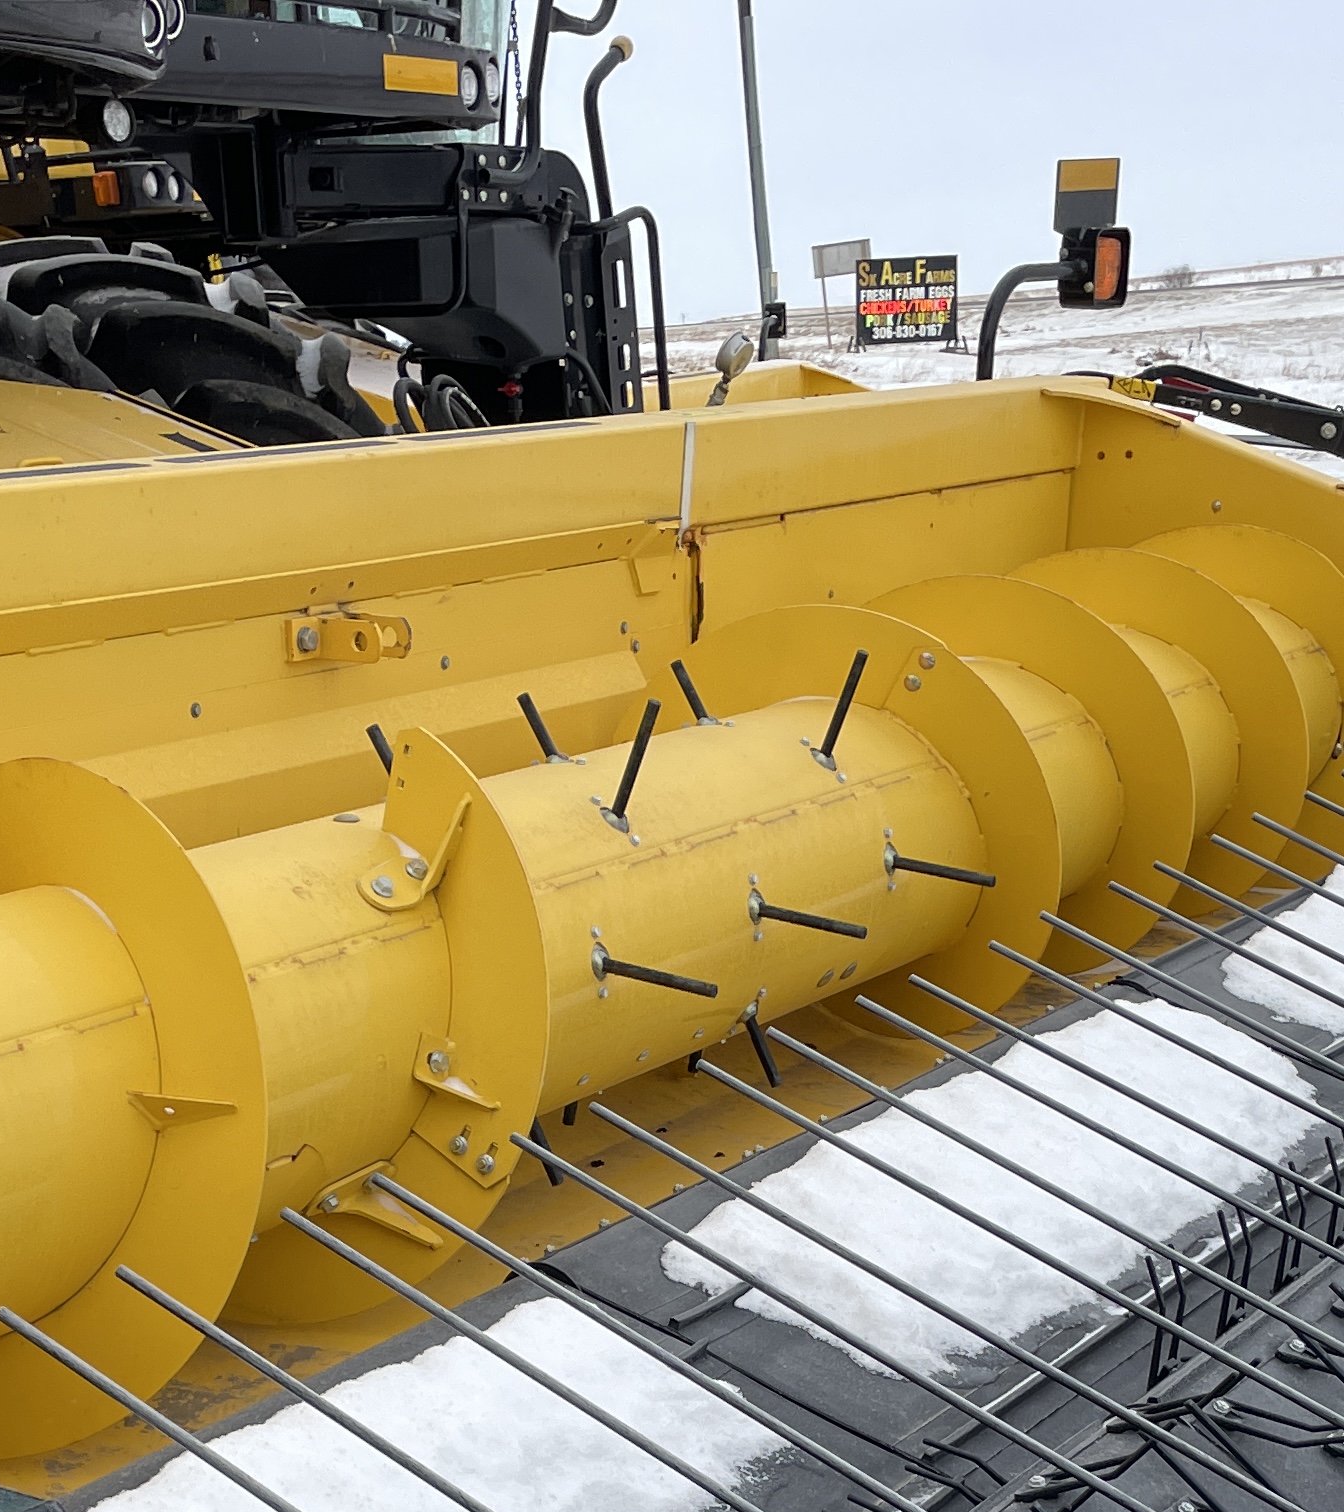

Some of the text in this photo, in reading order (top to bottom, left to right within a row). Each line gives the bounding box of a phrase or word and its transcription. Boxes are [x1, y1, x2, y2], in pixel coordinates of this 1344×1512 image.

[915, 259, 955, 284] FARMS
[860, 284, 954, 302] FRESH FARM EGGS
[865, 313, 894, 328] PORK
[904, 311, 950, 325] SAUSAGE
